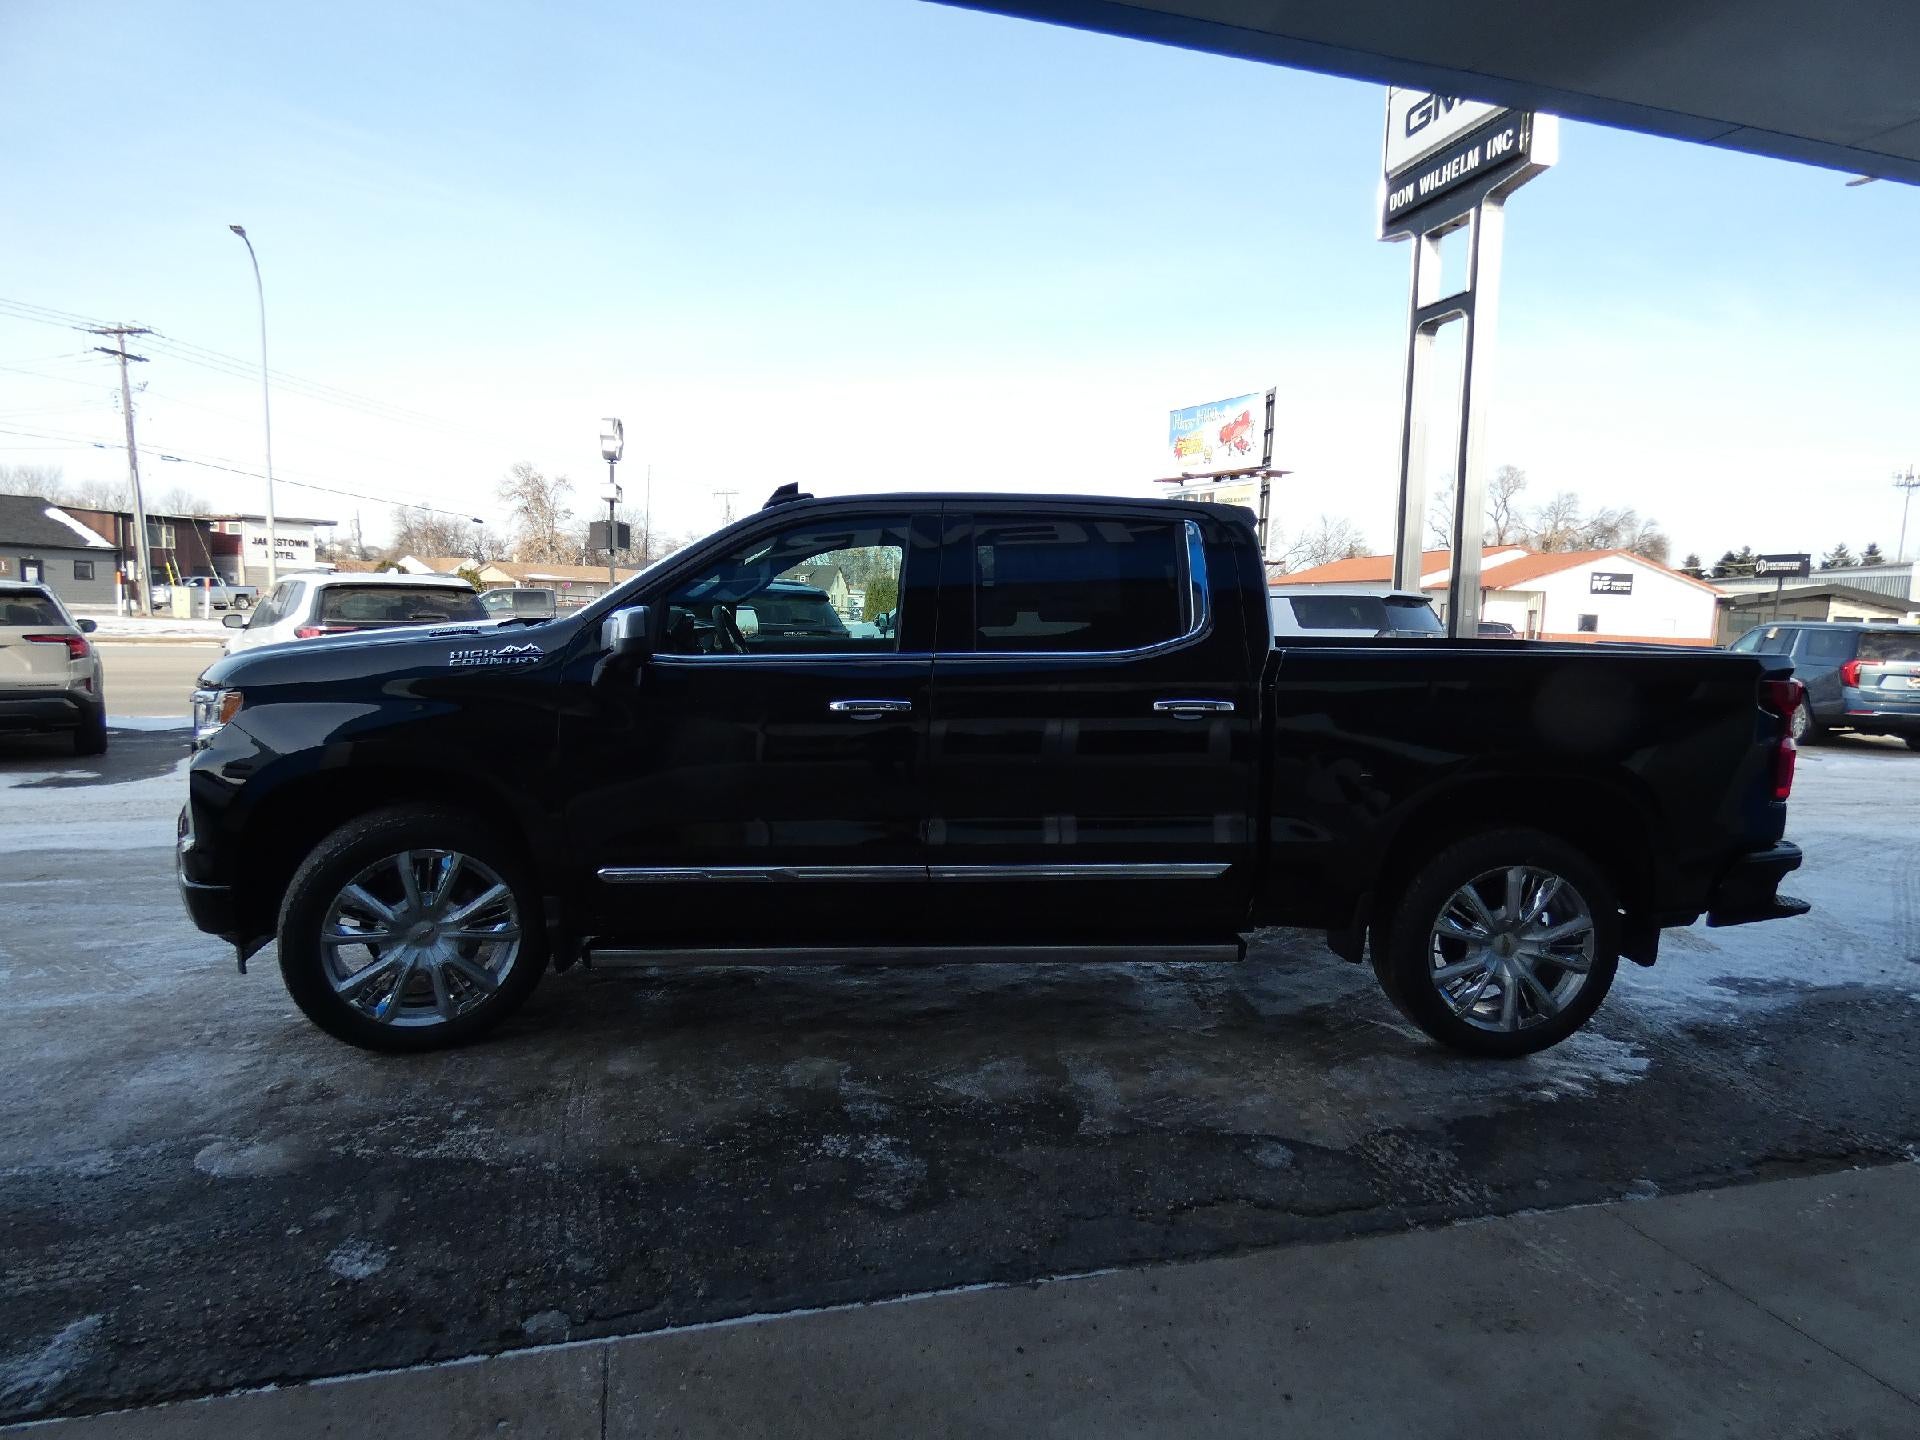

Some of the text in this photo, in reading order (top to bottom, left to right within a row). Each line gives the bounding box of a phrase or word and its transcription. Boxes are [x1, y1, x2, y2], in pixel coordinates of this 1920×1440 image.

[1389, 129, 1514, 212] DON WILHELM INC
[449, 649, 500, 659] HIGH
[449, 656, 543, 667] COUNTRY
